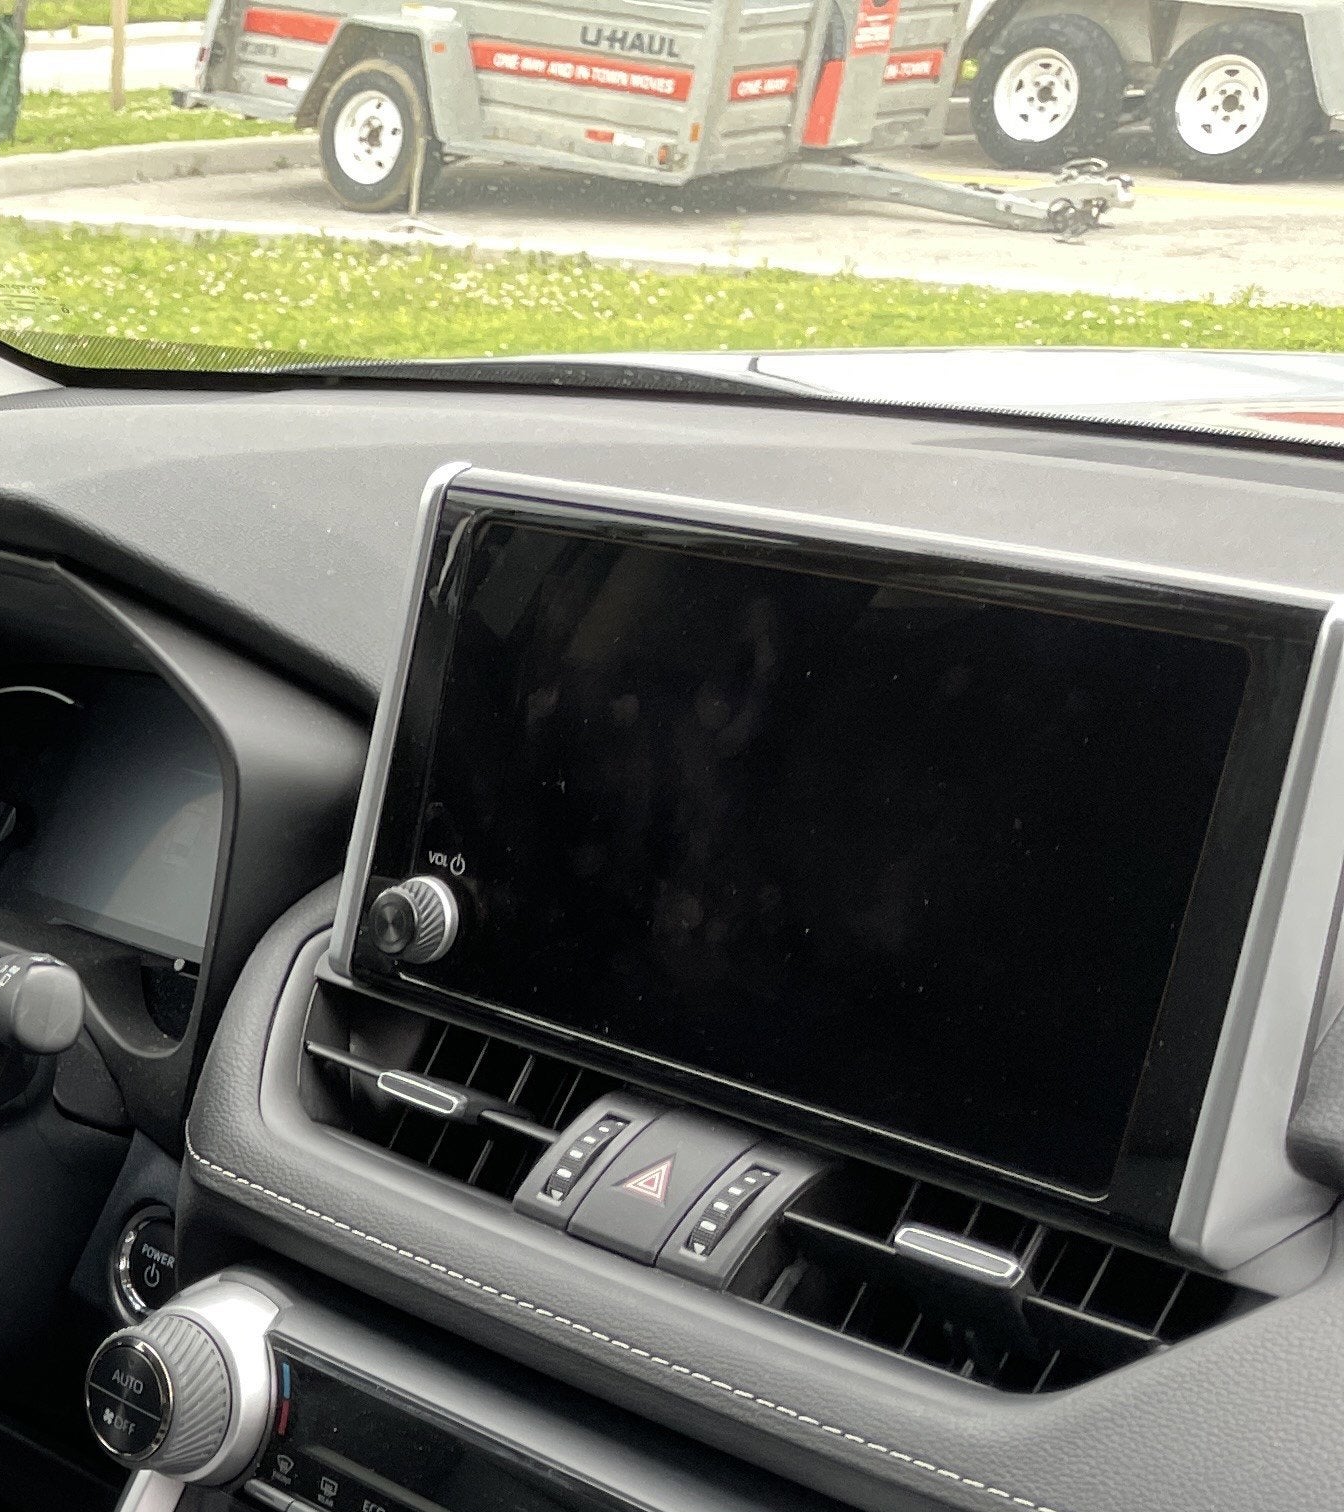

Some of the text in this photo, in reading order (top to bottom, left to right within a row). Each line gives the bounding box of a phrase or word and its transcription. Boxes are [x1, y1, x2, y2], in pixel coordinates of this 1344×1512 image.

[580, 25, 680, 57] U-HAUL
[428, 850, 448, 868] VOL
[141, 1242, 175, 1269] POWER
[112, 1368, 144, 1395] AUTO
[113, 1415, 135, 1436] OFF
